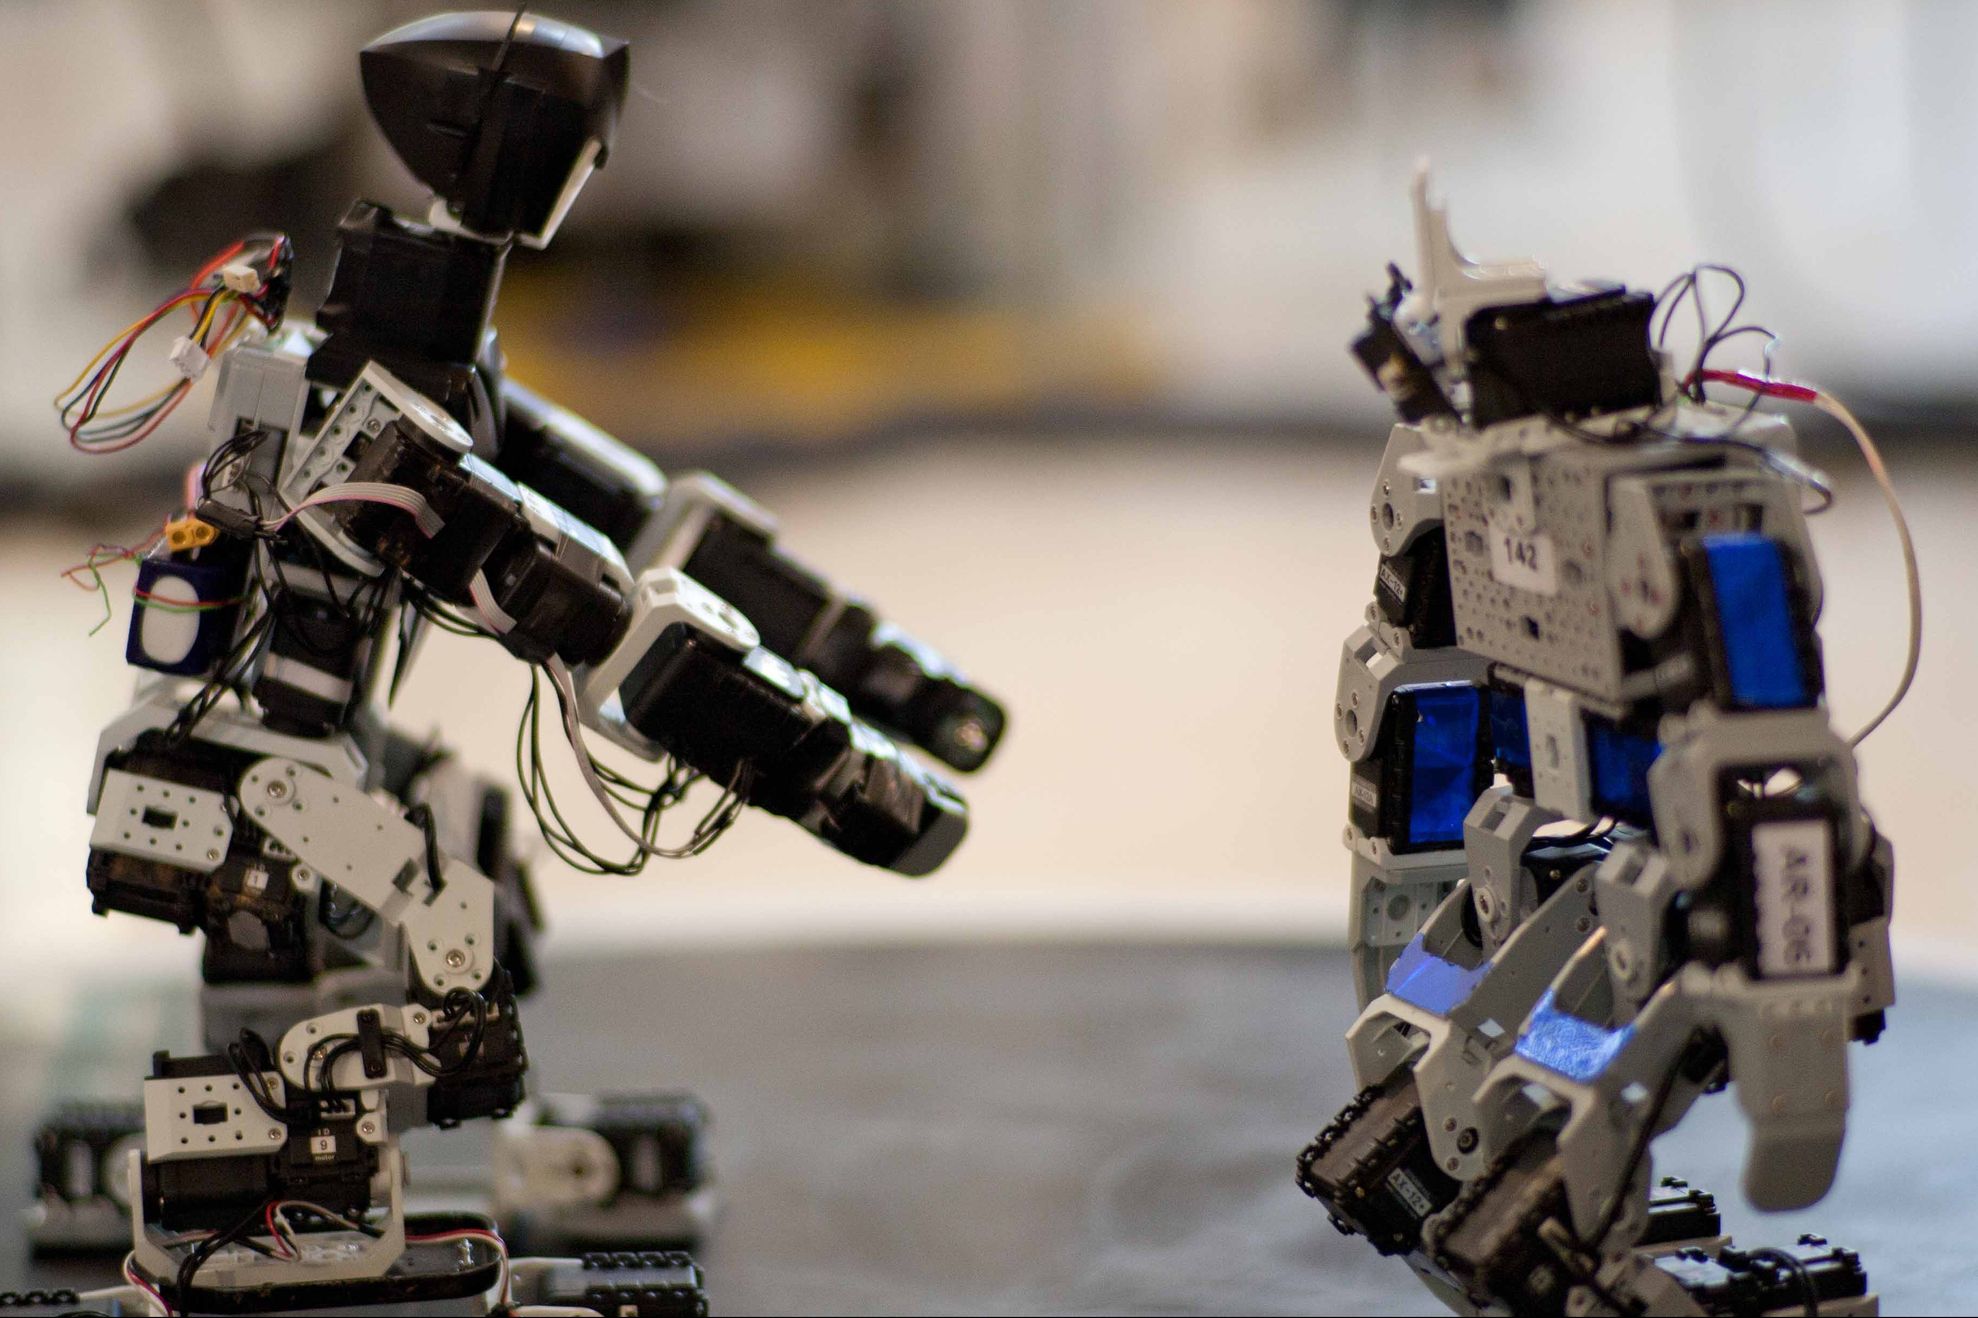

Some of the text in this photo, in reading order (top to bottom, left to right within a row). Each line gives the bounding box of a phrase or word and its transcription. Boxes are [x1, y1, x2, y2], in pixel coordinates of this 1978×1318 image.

[1504, 537, 1538, 571] 142
[320, 1140, 328, 1151] 9
[1390, 1172, 1425, 1210] AX-12+
